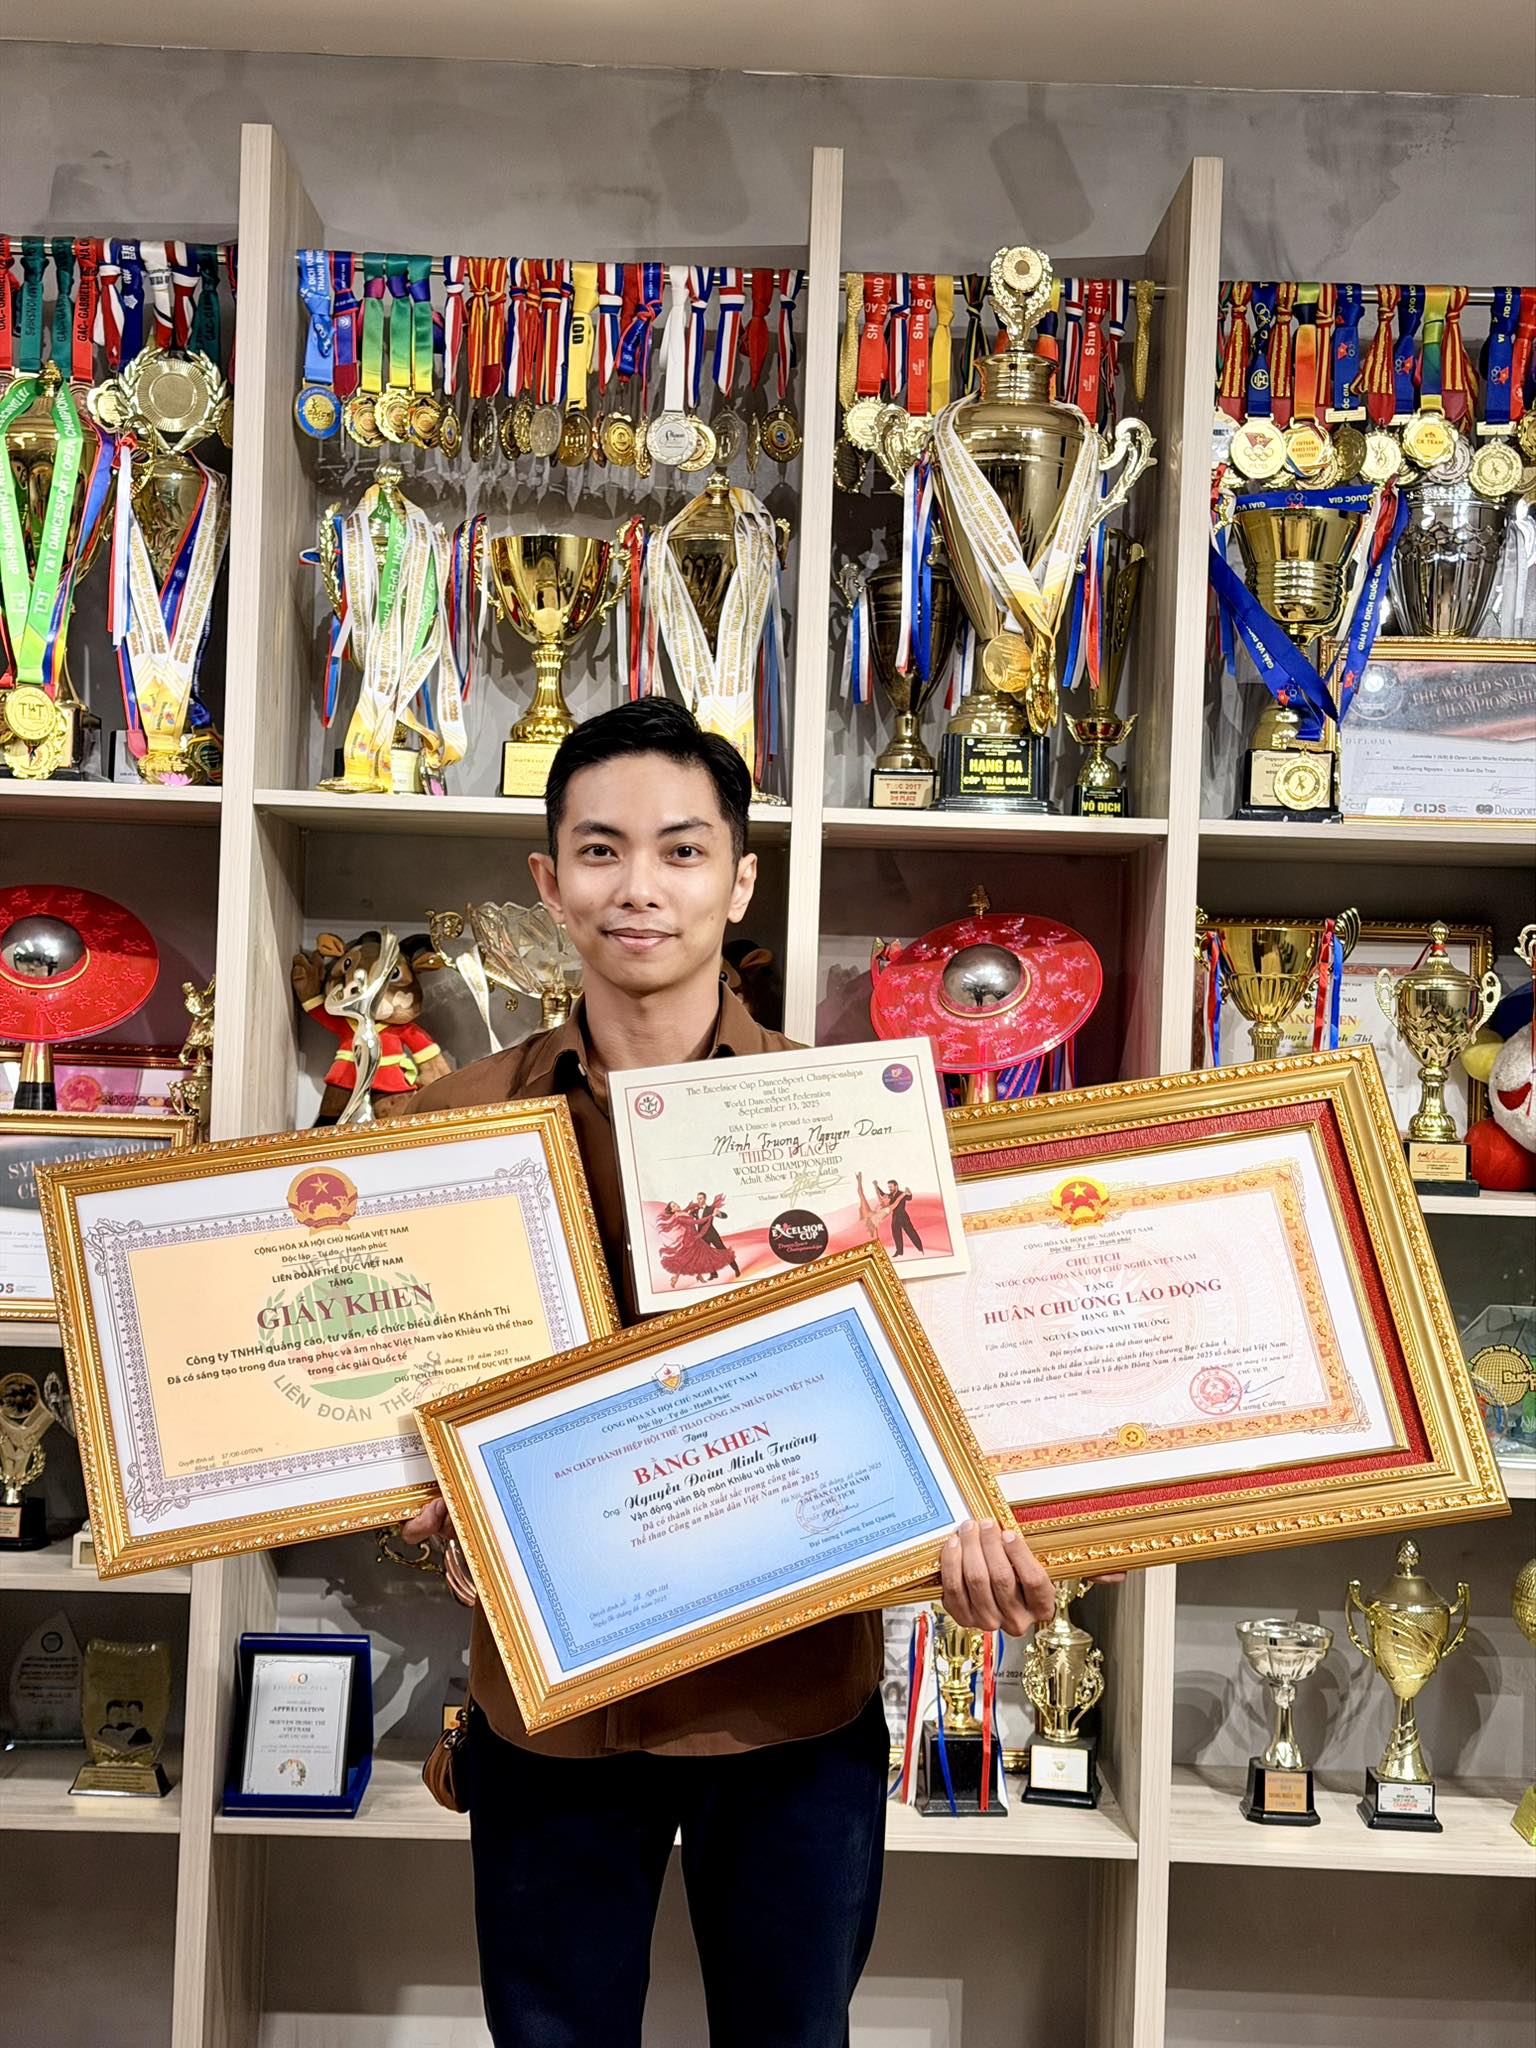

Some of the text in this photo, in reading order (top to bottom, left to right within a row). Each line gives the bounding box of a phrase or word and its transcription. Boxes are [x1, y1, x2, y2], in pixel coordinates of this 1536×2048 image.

[969, 759, 1024, 776] HẠNG BA
[685, 1087, 700, 1096] The
[738, 1080, 756, 1090] Cup
[723, 1099, 746, 1108] World
[738, 1102, 784, 1118] September
[738, 1148, 784, 1163] THIRD
[732, 1164, 769, 1175] WORLD
[771, 1219, 824, 1240] EXCELSIOR
[798, 1230, 819, 1240] CUP
[257, 1283, 432, 1329] GIẤY KHEN
[984, 1279, 1221, 1324] HUÂN CHƯƠNG LAO ĐỘNG
[186, 1305, 510, 1365] Công ty TNHH quảng cáo, tư vấn, tổ chức biểu diễn Khánh Thi
[167, 1319, 533, 1384] Đã có sáng tạo trong đưa trang phục và âm nhạc Việt Nam vào Khiêu vũ thể thao
[307, 1351, 407, 1375] trong các giải Quốc tế
[633, 1422, 770, 1484] BẰNG KHEN
[630, 1454, 800, 1521] Vận động viên Bộ môn Khiêu vũ thể thao
